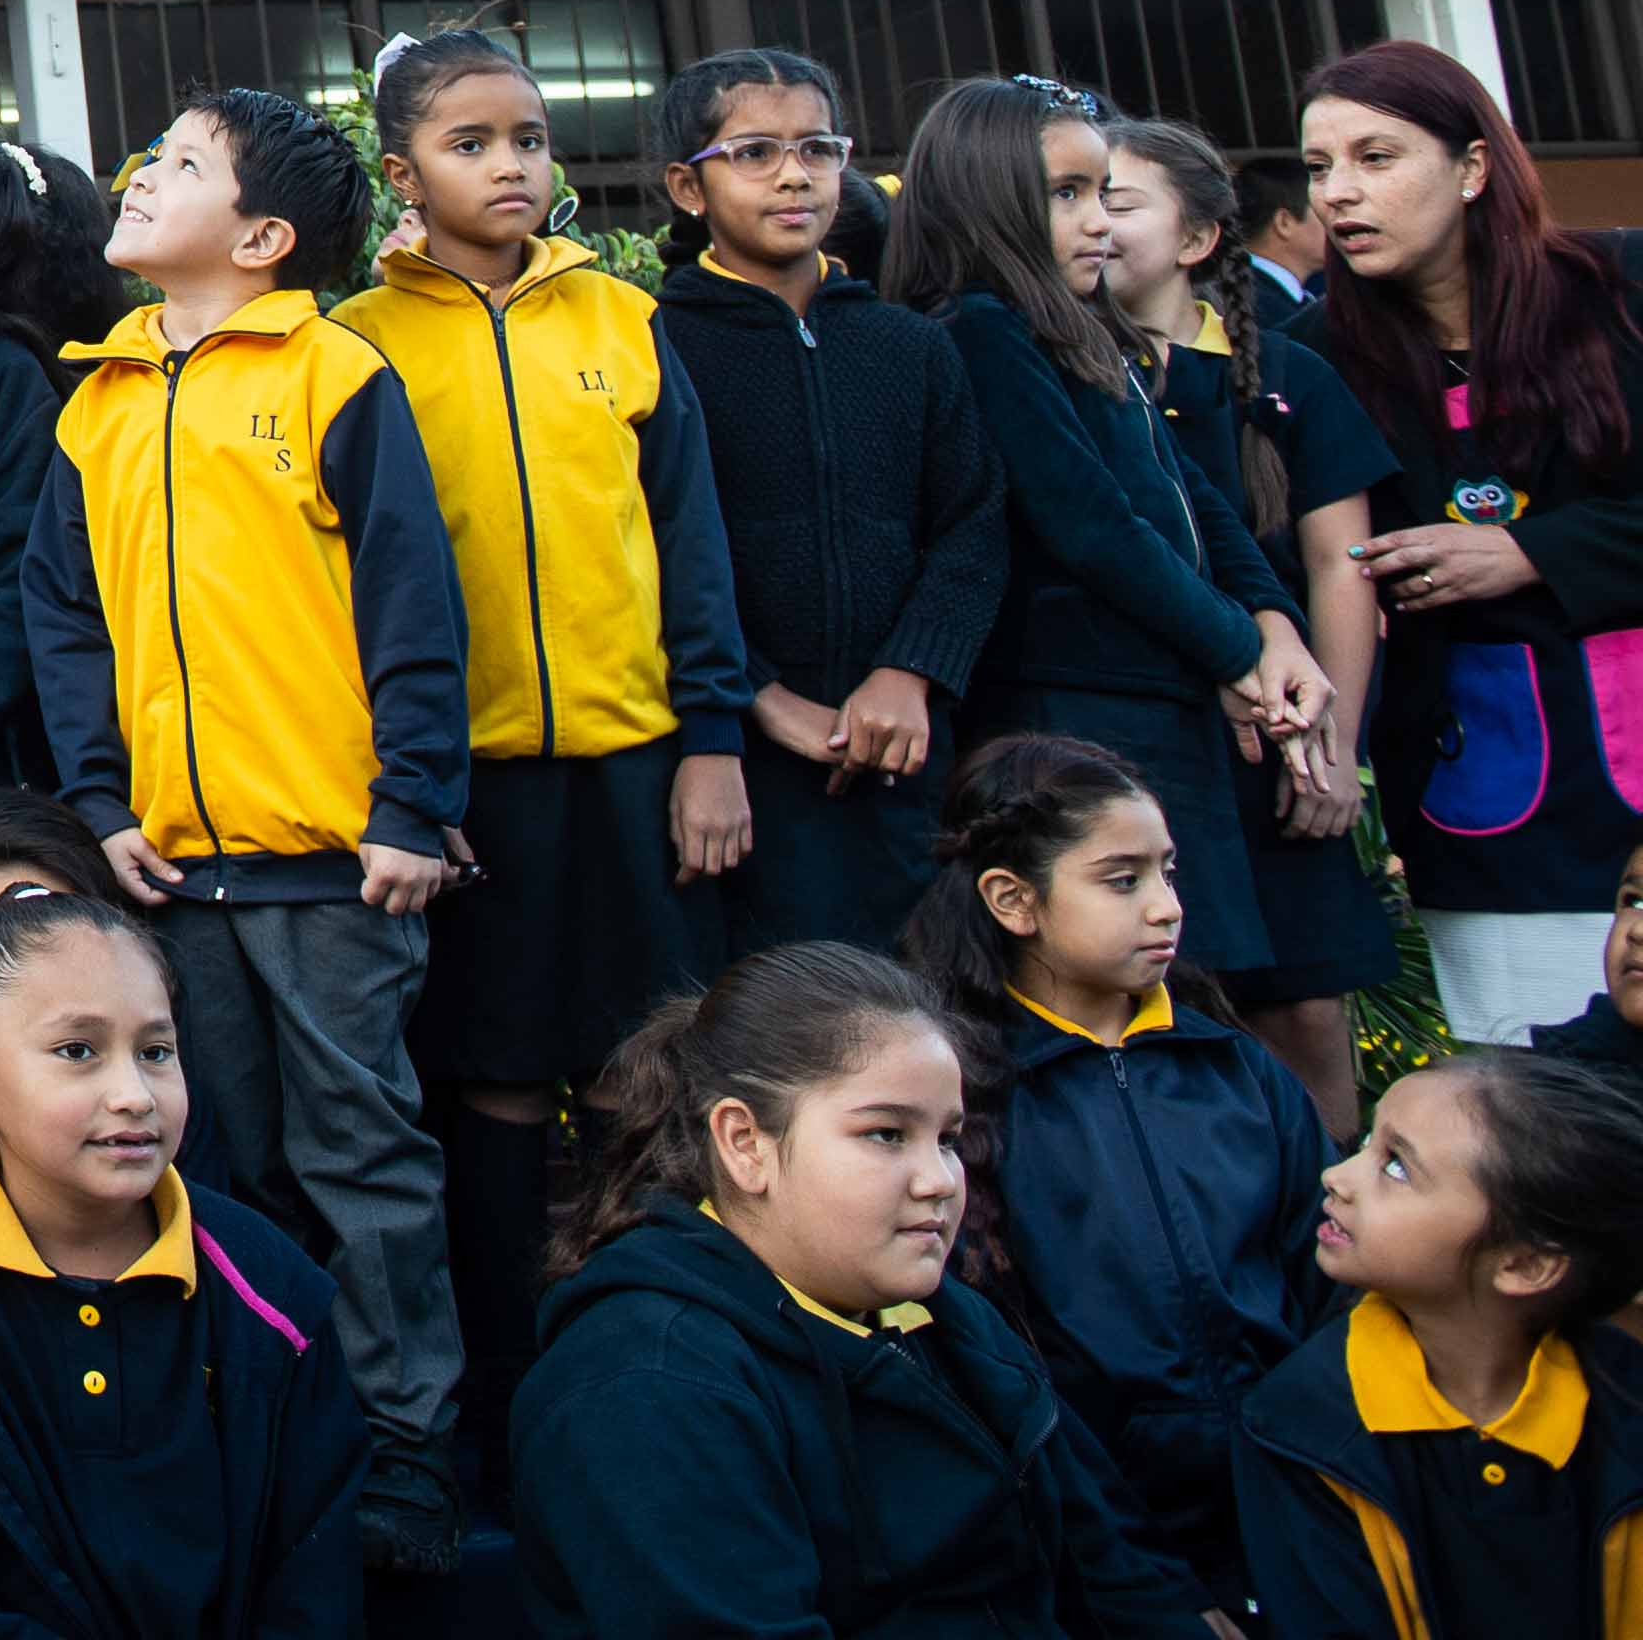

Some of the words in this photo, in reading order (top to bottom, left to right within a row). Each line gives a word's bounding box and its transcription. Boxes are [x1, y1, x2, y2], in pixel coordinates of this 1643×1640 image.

[578, 370, 613, 392] LL
[250, 414, 286, 441] LL
[275, 448, 291, 472] S
